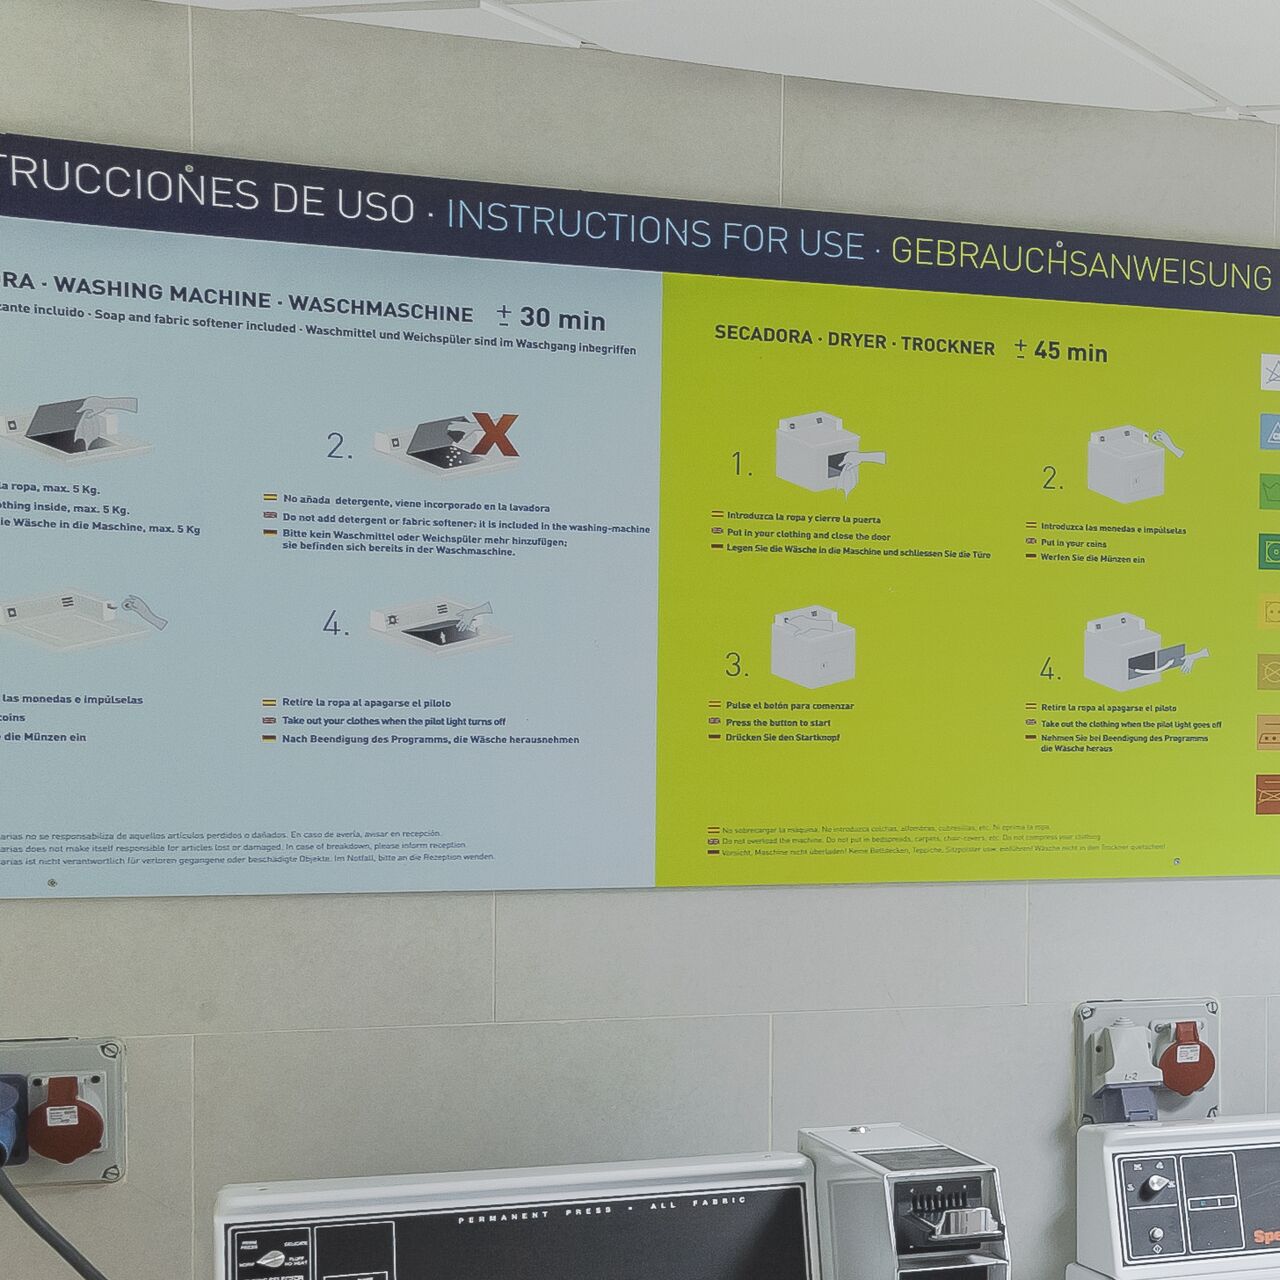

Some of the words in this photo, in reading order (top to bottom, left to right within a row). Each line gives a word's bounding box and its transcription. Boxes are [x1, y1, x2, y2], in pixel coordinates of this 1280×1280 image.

[275, 183, 324, 216] DE
[339, 189, 413, 224] USO
[448, 198, 711, 249] INSTRUCTIONS
[725, 222, 787, 255] FOR
[801, 228, 864, 260] USE
[893, 237, 1271, 291] GEBRAUCHSANWEISUNG
[54, 275, 162, 300] WASHING
[171, 285, 270, 309] MACHINE
[288, 293, 474, 324] WASCHMASCHINE
[521, 306, 549, 328] 30
[559, 310, 604, 332] min
[35, 304, 84, 318] incluido
[95, 309, 125, 323] Soap
[129, 313, 150, 323] and
[155, 313, 189, 326] fabric
[193, 317, 243, 330] softener
[247, 320, 295, 333] included
[306, 324, 376, 339] Waschmittel
[380, 331, 400, 340] und
[475, 336, 497, 347] sind
[500, 337, 513, 347] im
[516, 338, 576, 354] Waschgang
[579, 342, 636, 356] inbegriffen
[716, 324, 812, 345] SECADORA
[829, 331, 886, 349] DRYER
[901, 336, 994, 356] TROCKNER
[1035, 340, 1059, 360] 45
[1068, 343, 1107, 363] min
[328, 432, 352, 459] 2.
[733, 451, 752, 476] 1.
[1043, 466, 1062, 490] 2.
[323, 610, 348, 636] 4.
[726, 652, 748, 677] 3.
[1040, 656, 1060, 680] 4.
[458, 1210, 549, 1225] PERMANENT
[565, 1206, 612, 1217] PRESS
[650, 1200, 677, 1210] ALL
[692, 1196, 747, 1207] FABRIC
